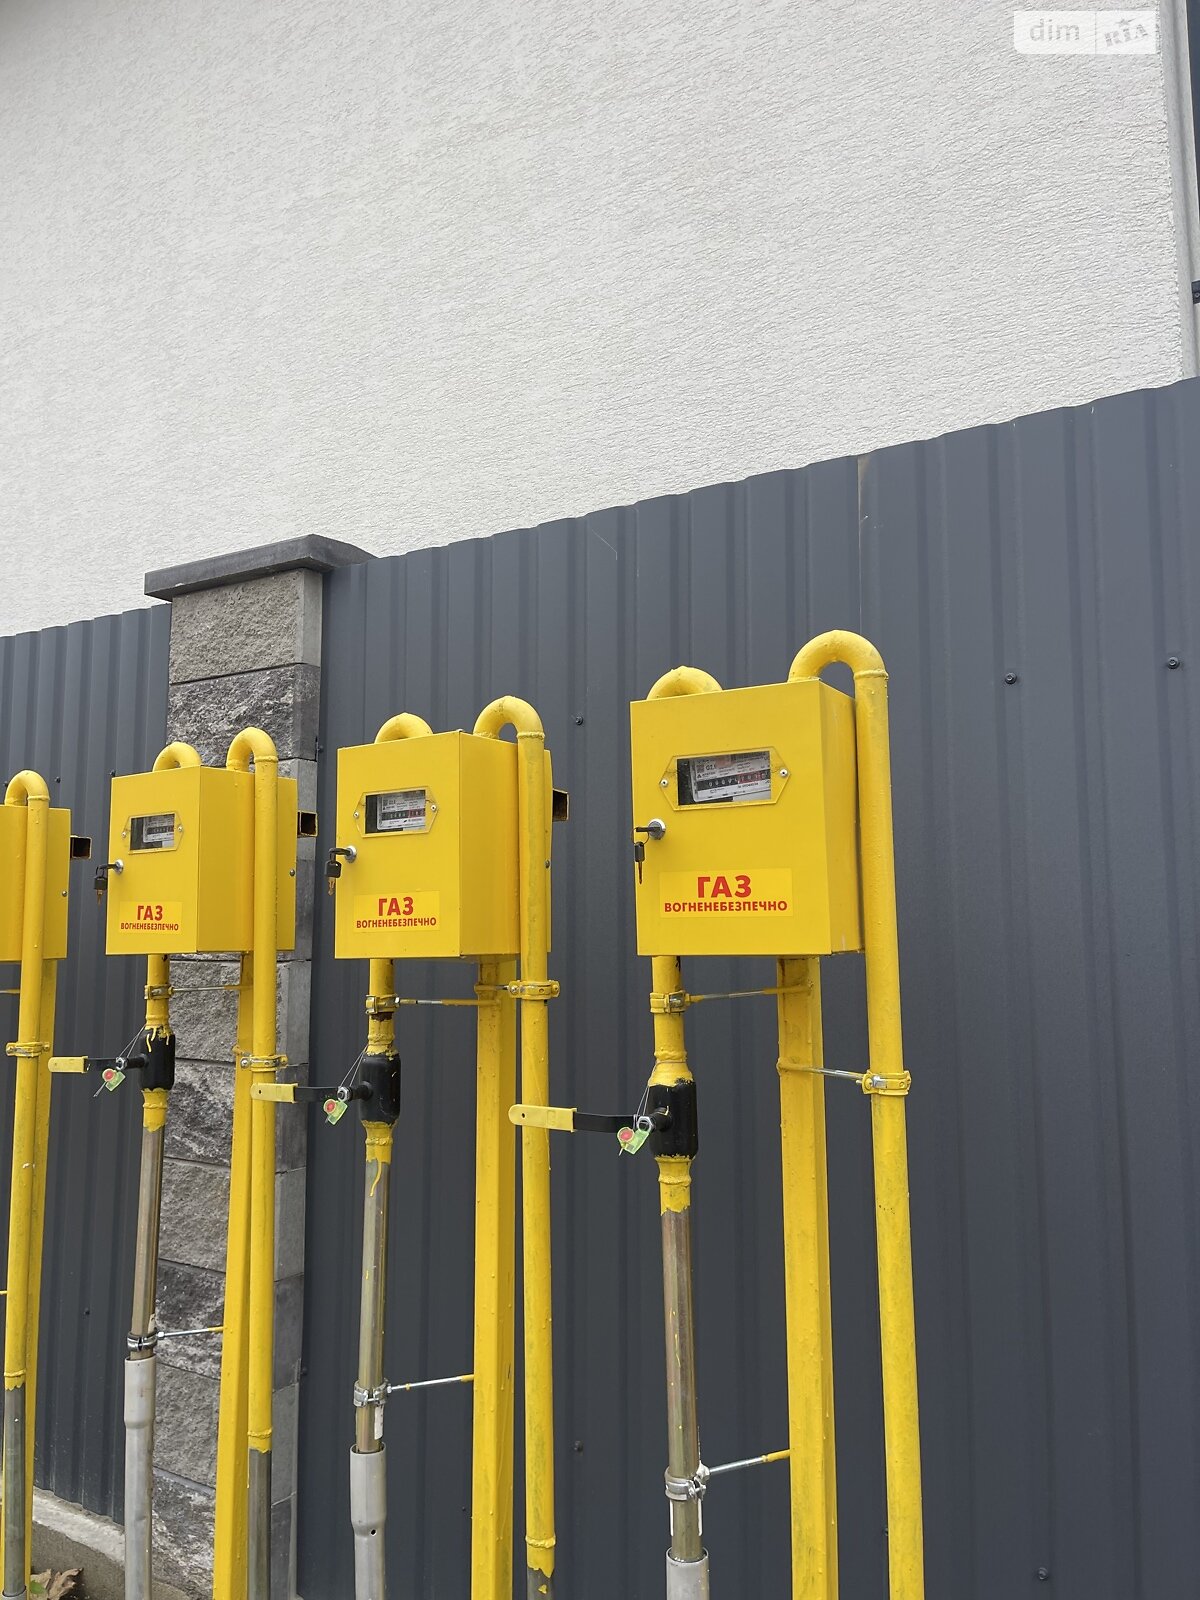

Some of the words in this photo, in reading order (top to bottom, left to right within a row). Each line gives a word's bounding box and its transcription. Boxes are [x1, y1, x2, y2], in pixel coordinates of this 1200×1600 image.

[697, 875, 752, 898] ГАЗ
[137, 905, 163, 921] ГАЗ
[378, 896, 414, 916] ГАЗ
[664, 900, 788, 913] ВОГНЕНЕБЕЗПЕЧНО
[120, 922, 179, 931] ВОГНЕНЕБЕЗПЕЧНО
[356, 917, 437, 929] ВОГНЕНЕБЕЗПЕЧНО
